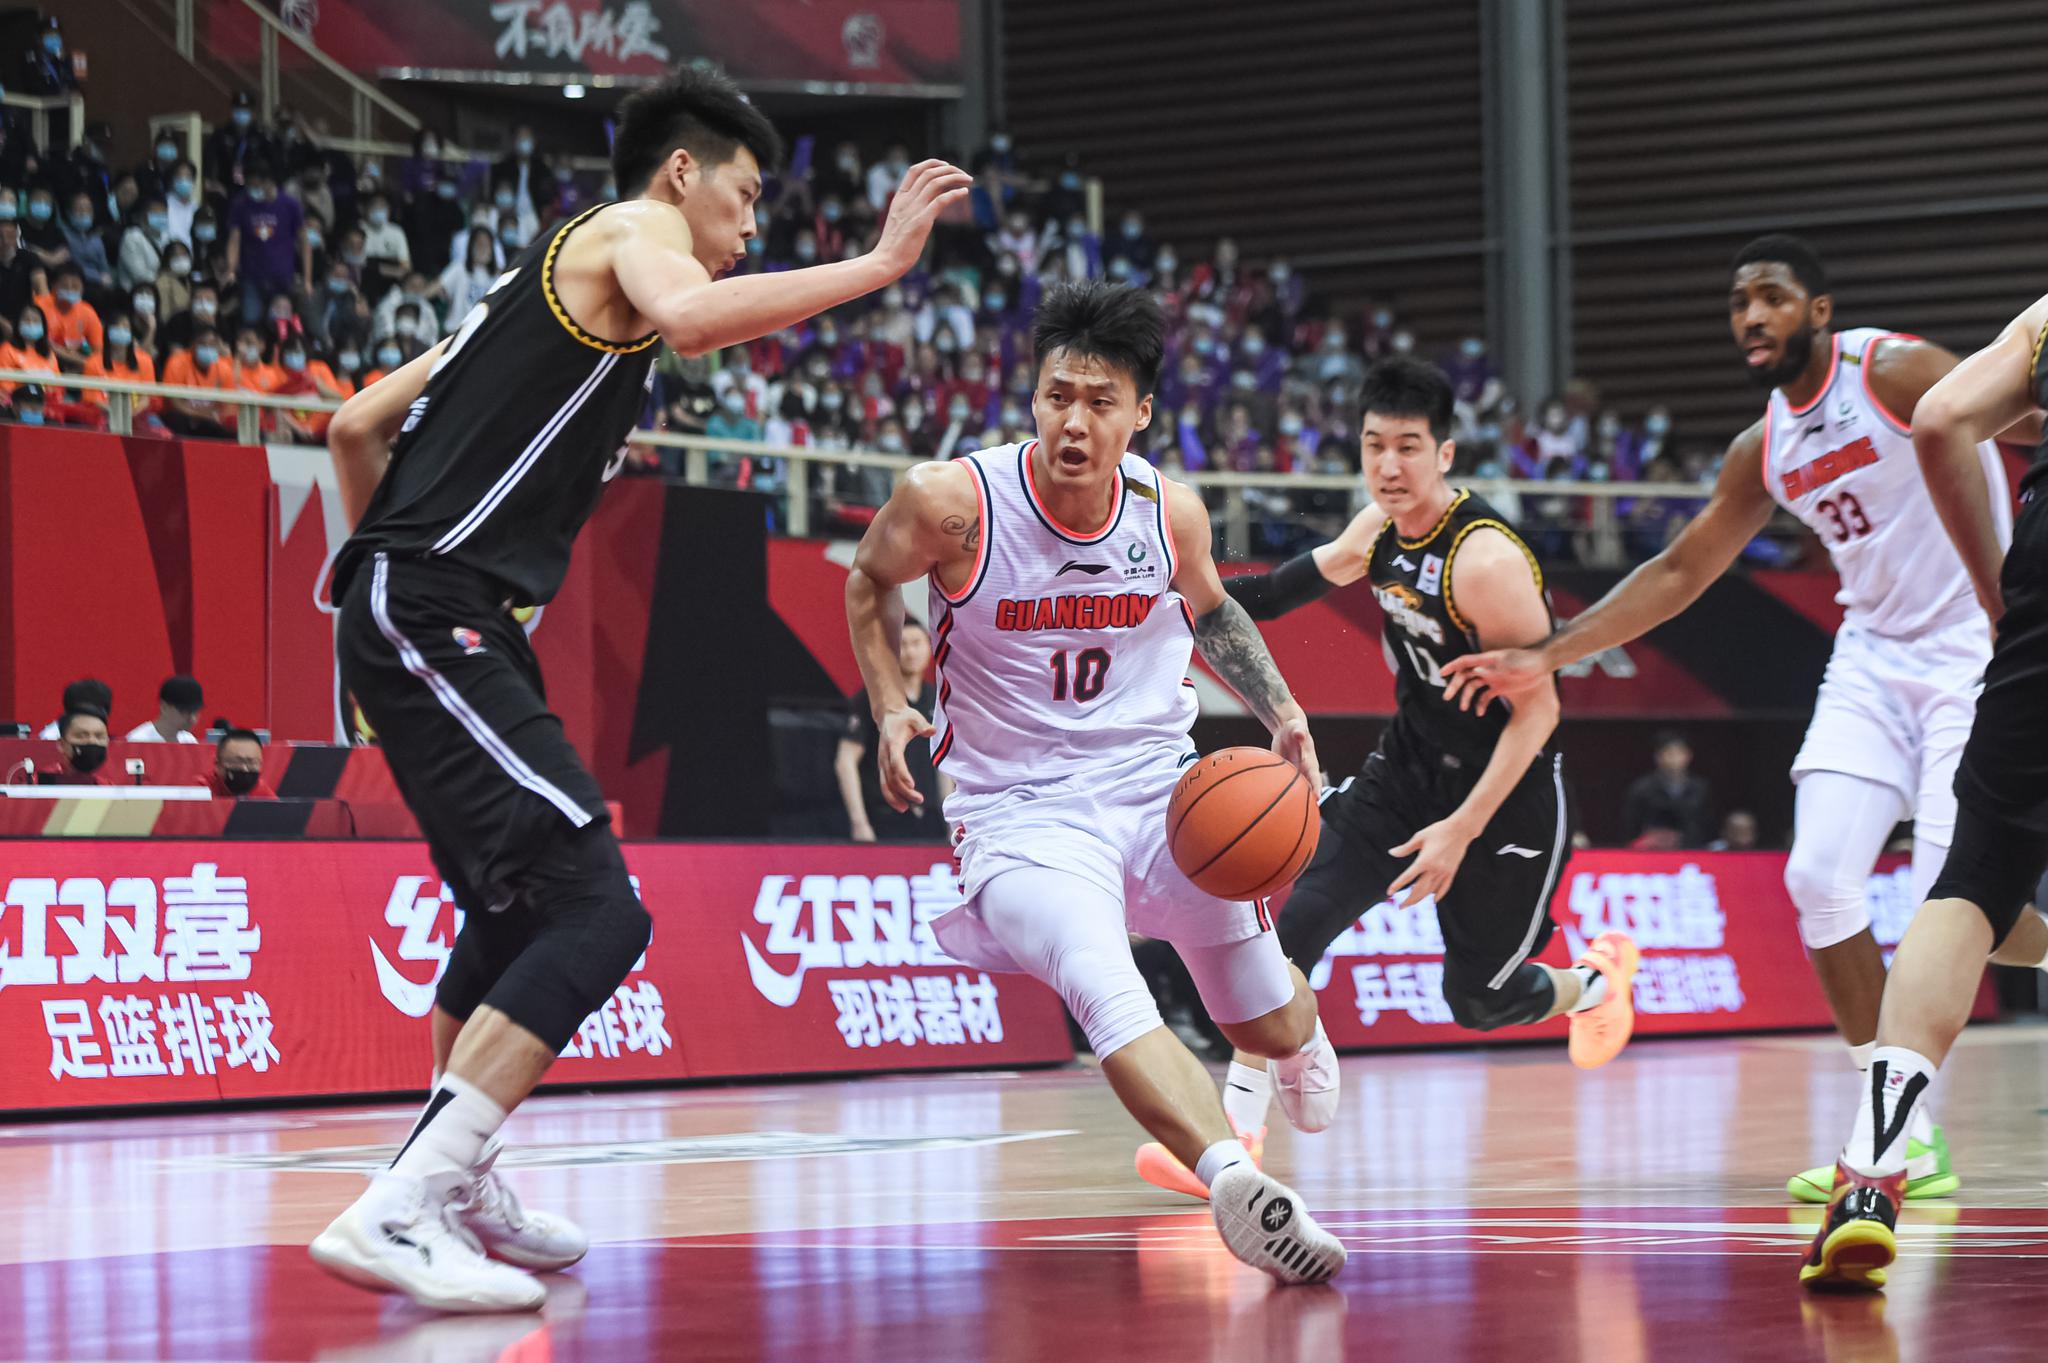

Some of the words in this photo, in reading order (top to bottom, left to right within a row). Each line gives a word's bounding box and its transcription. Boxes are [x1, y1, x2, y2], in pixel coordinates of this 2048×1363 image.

[1816, 491, 1873, 543] 33
[1050, 647, 1111, 703] 10
[41, 991, 281, 1081] 足篮排球
[827, 972, 1004, 1048] 羽球器材
